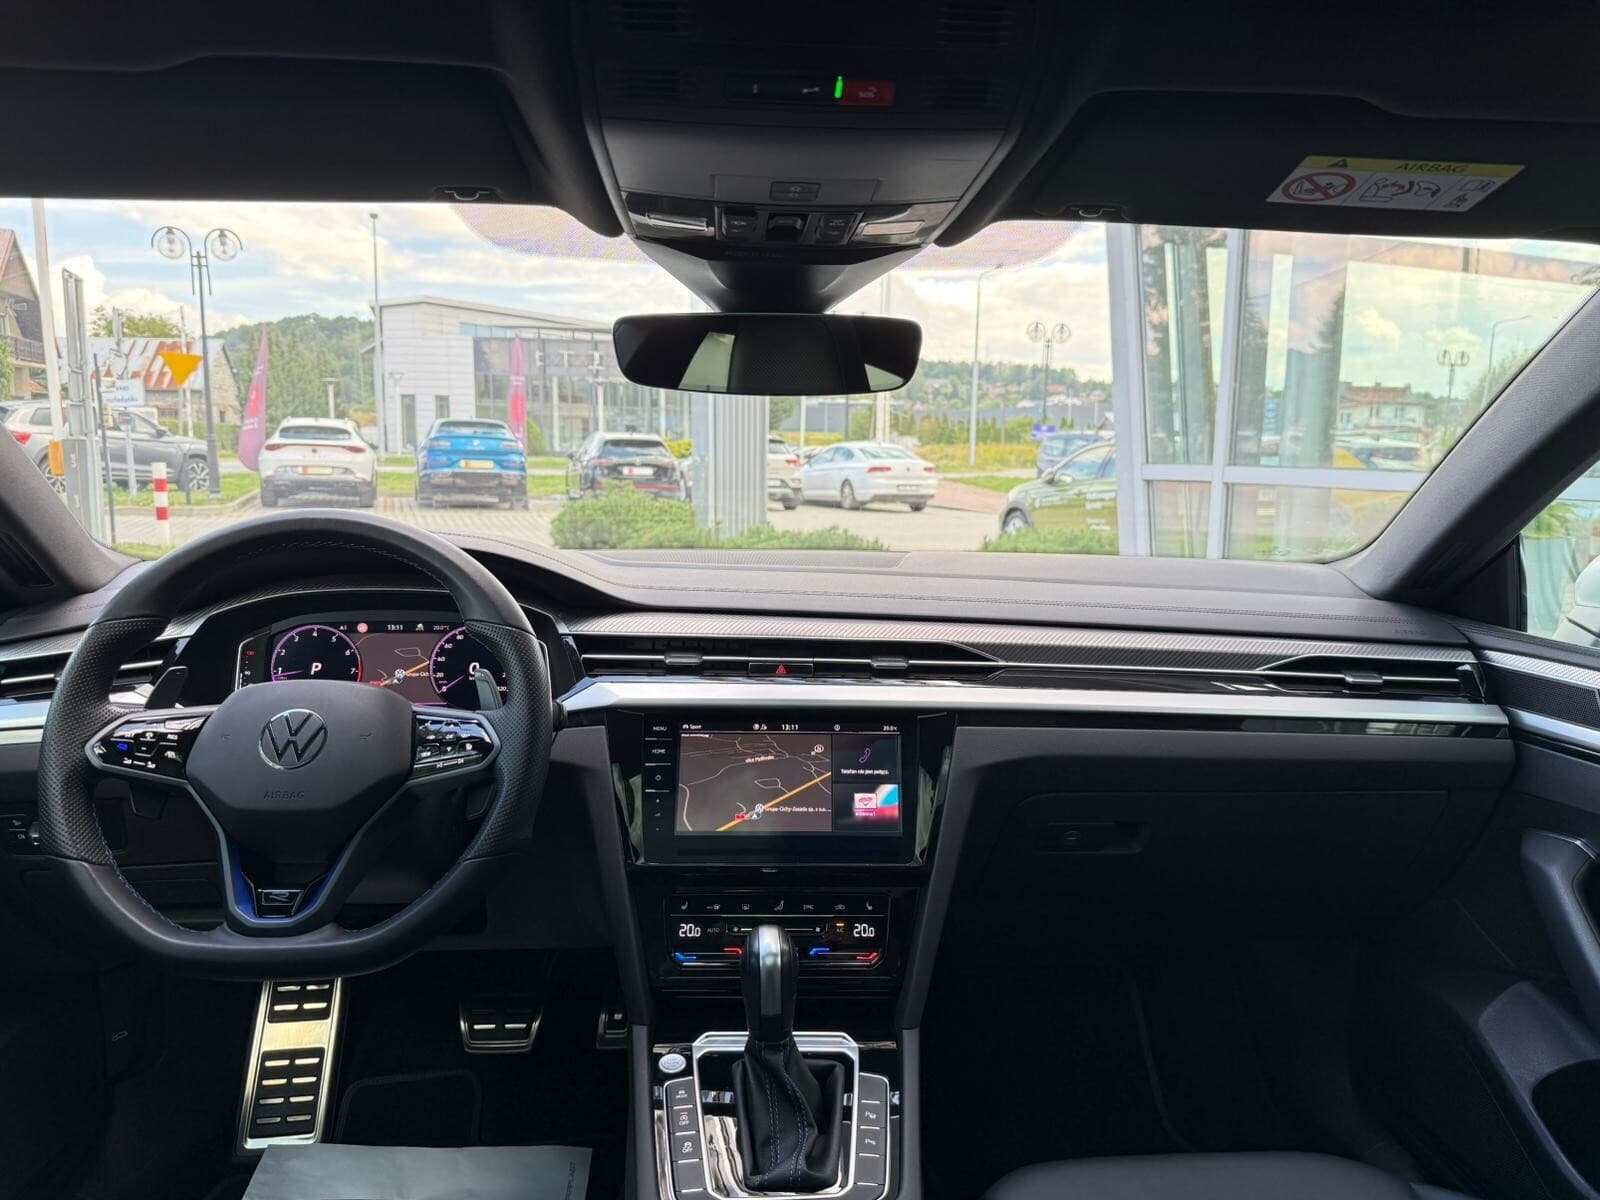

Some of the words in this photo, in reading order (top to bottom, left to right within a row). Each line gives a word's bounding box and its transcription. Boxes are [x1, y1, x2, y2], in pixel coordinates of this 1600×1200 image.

[1396, 162, 1469, 174] AIRBAG
[310, 662, 322, 675] P
[263, 790, 305, 800] AIRBAG
[678, 923, 701, 937] 20.0
[853, 923, 875, 937] 20.0
